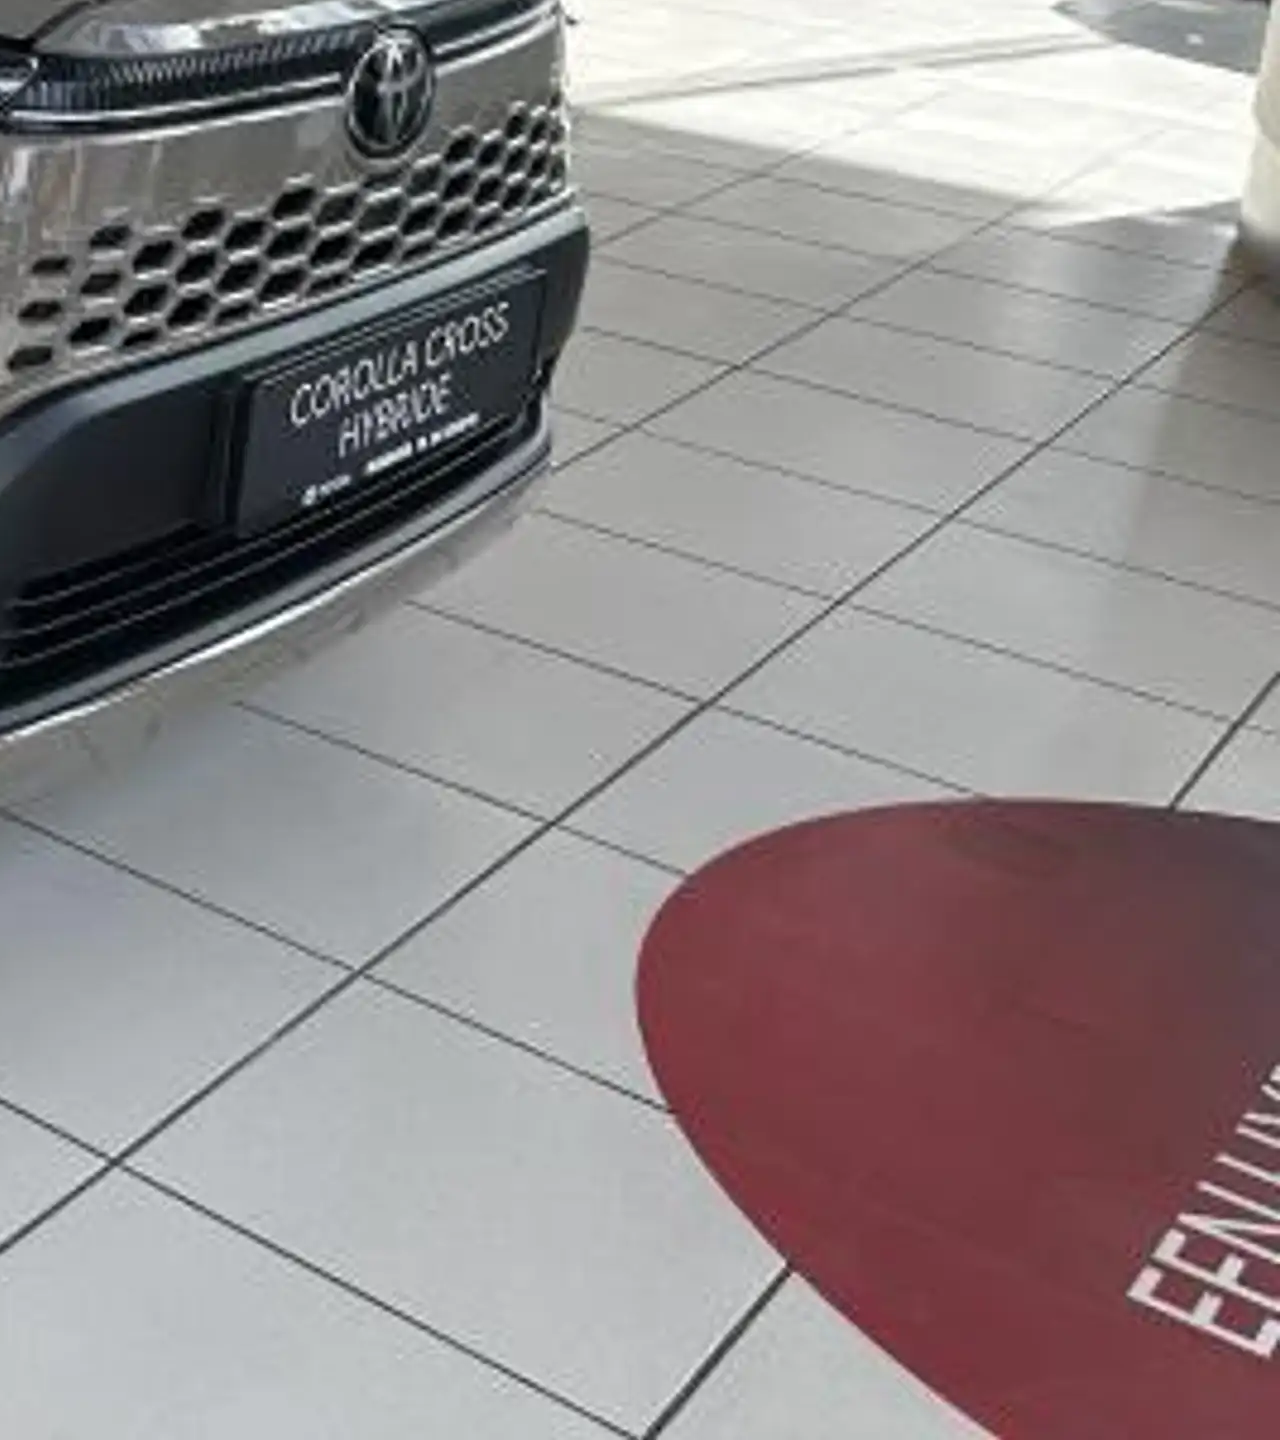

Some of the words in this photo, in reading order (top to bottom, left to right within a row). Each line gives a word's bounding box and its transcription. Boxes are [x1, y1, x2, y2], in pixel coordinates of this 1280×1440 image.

[291, 340, 419, 428] COROLLA
[424, 301, 511, 368] CROSS
[338, 371, 454, 459] HYBRIDE
